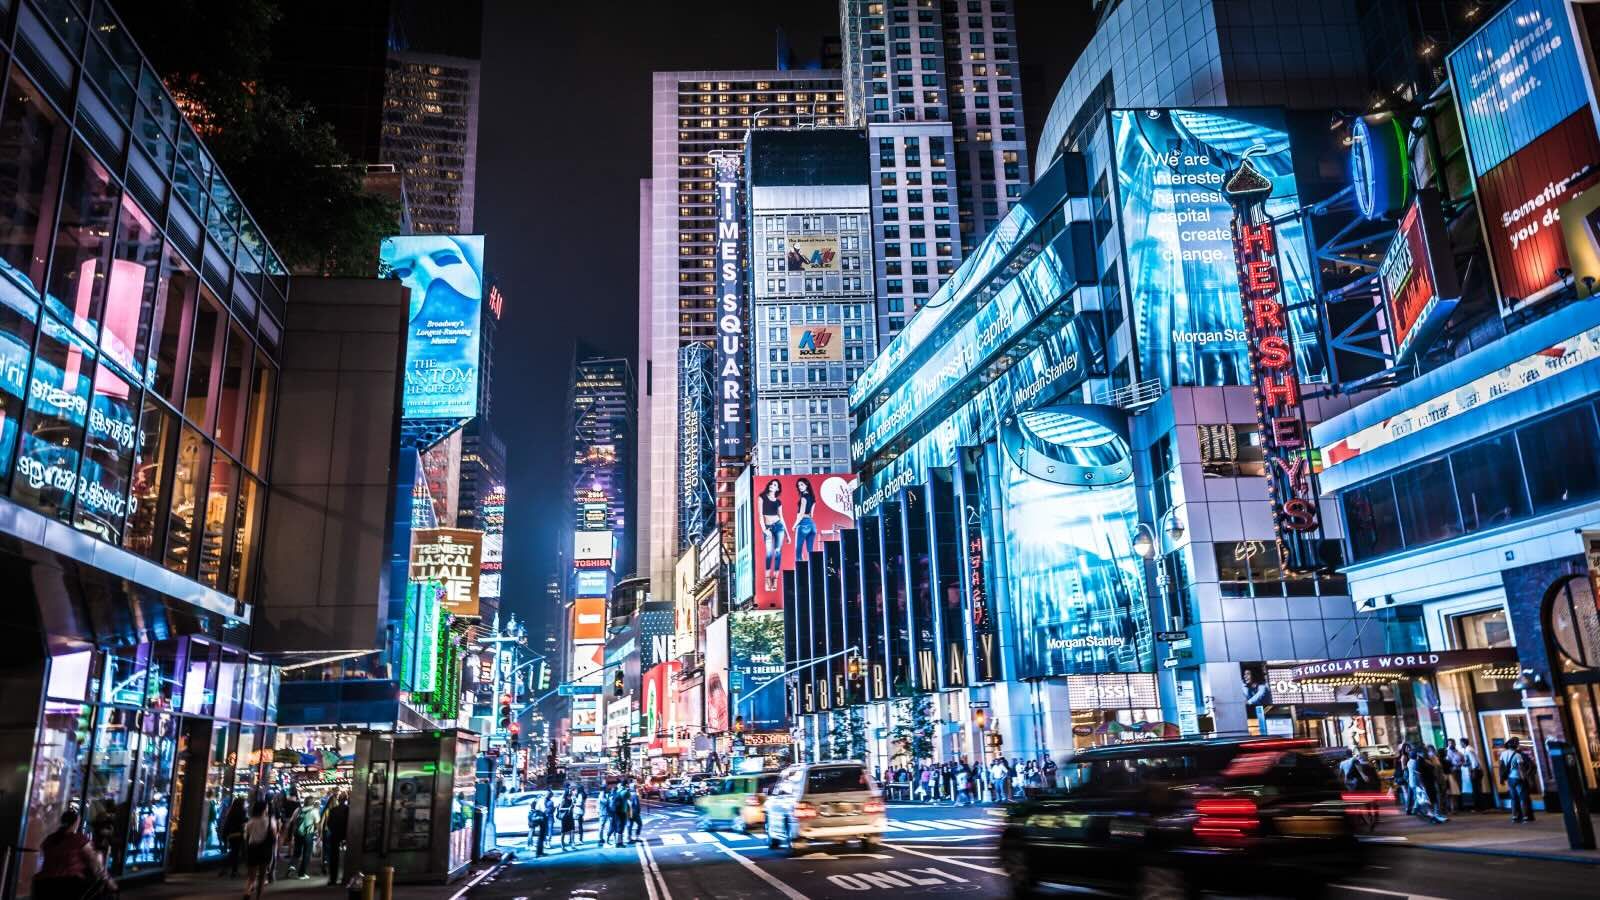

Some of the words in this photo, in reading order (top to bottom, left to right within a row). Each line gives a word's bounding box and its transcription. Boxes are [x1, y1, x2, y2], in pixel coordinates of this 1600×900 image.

[1469, 18, 1553, 88] Sometimes
[1472, 87, 1497, 115] you
[1498, 60, 1529, 88] feel
[1532, 34, 1563, 65] like
[1498, 98, 1508, 112] a
[1511, 79, 1541, 104] nut.
[1152, 153, 1179, 166] We
[1184, 155, 1210, 165] are
[1158, 208, 1210, 224] capital
[718, 182, 739, 282] TIMES
[1182, 229, 1231, 241] create
[1510, 218, 1539, 250] you
[1162, 248, 1227, 263] change.
[427, 320, 464, 329] Broadway's
[1172, 330, 1223, 344] Morgan
[413, 359, 438, 368] THE
[720, 293, 742, 423] SQUARE
[852, 440, 864, 461] We
[864, 431, 876, 452] are
[876, 400, 913, 440] interested
[976, 308, 1014, 350] capital
[1015, 373, 1046, 406] Morgan
[1045, 350, 1078, 384] Stanley
[724, 437, 740, 445] NYC
[684, 438, 693, 505] AMERICAN
[855, 503, 862, 520] to
[862, 489, 884, 514] create
[884, 467, 915, 499] change.
[574, 559, 611, 567] TOSHIBA
[1046, 638, 1086, 650] Morgan
[1086, 636, 1125, 648] Stanley
[1304, 660, 1370, 675] CHOCOLATE
[1379, 654, 1439, 668] WORLD
[793, 674, 845, 714] 1585
[827, 867, 970, 891] ONLY
